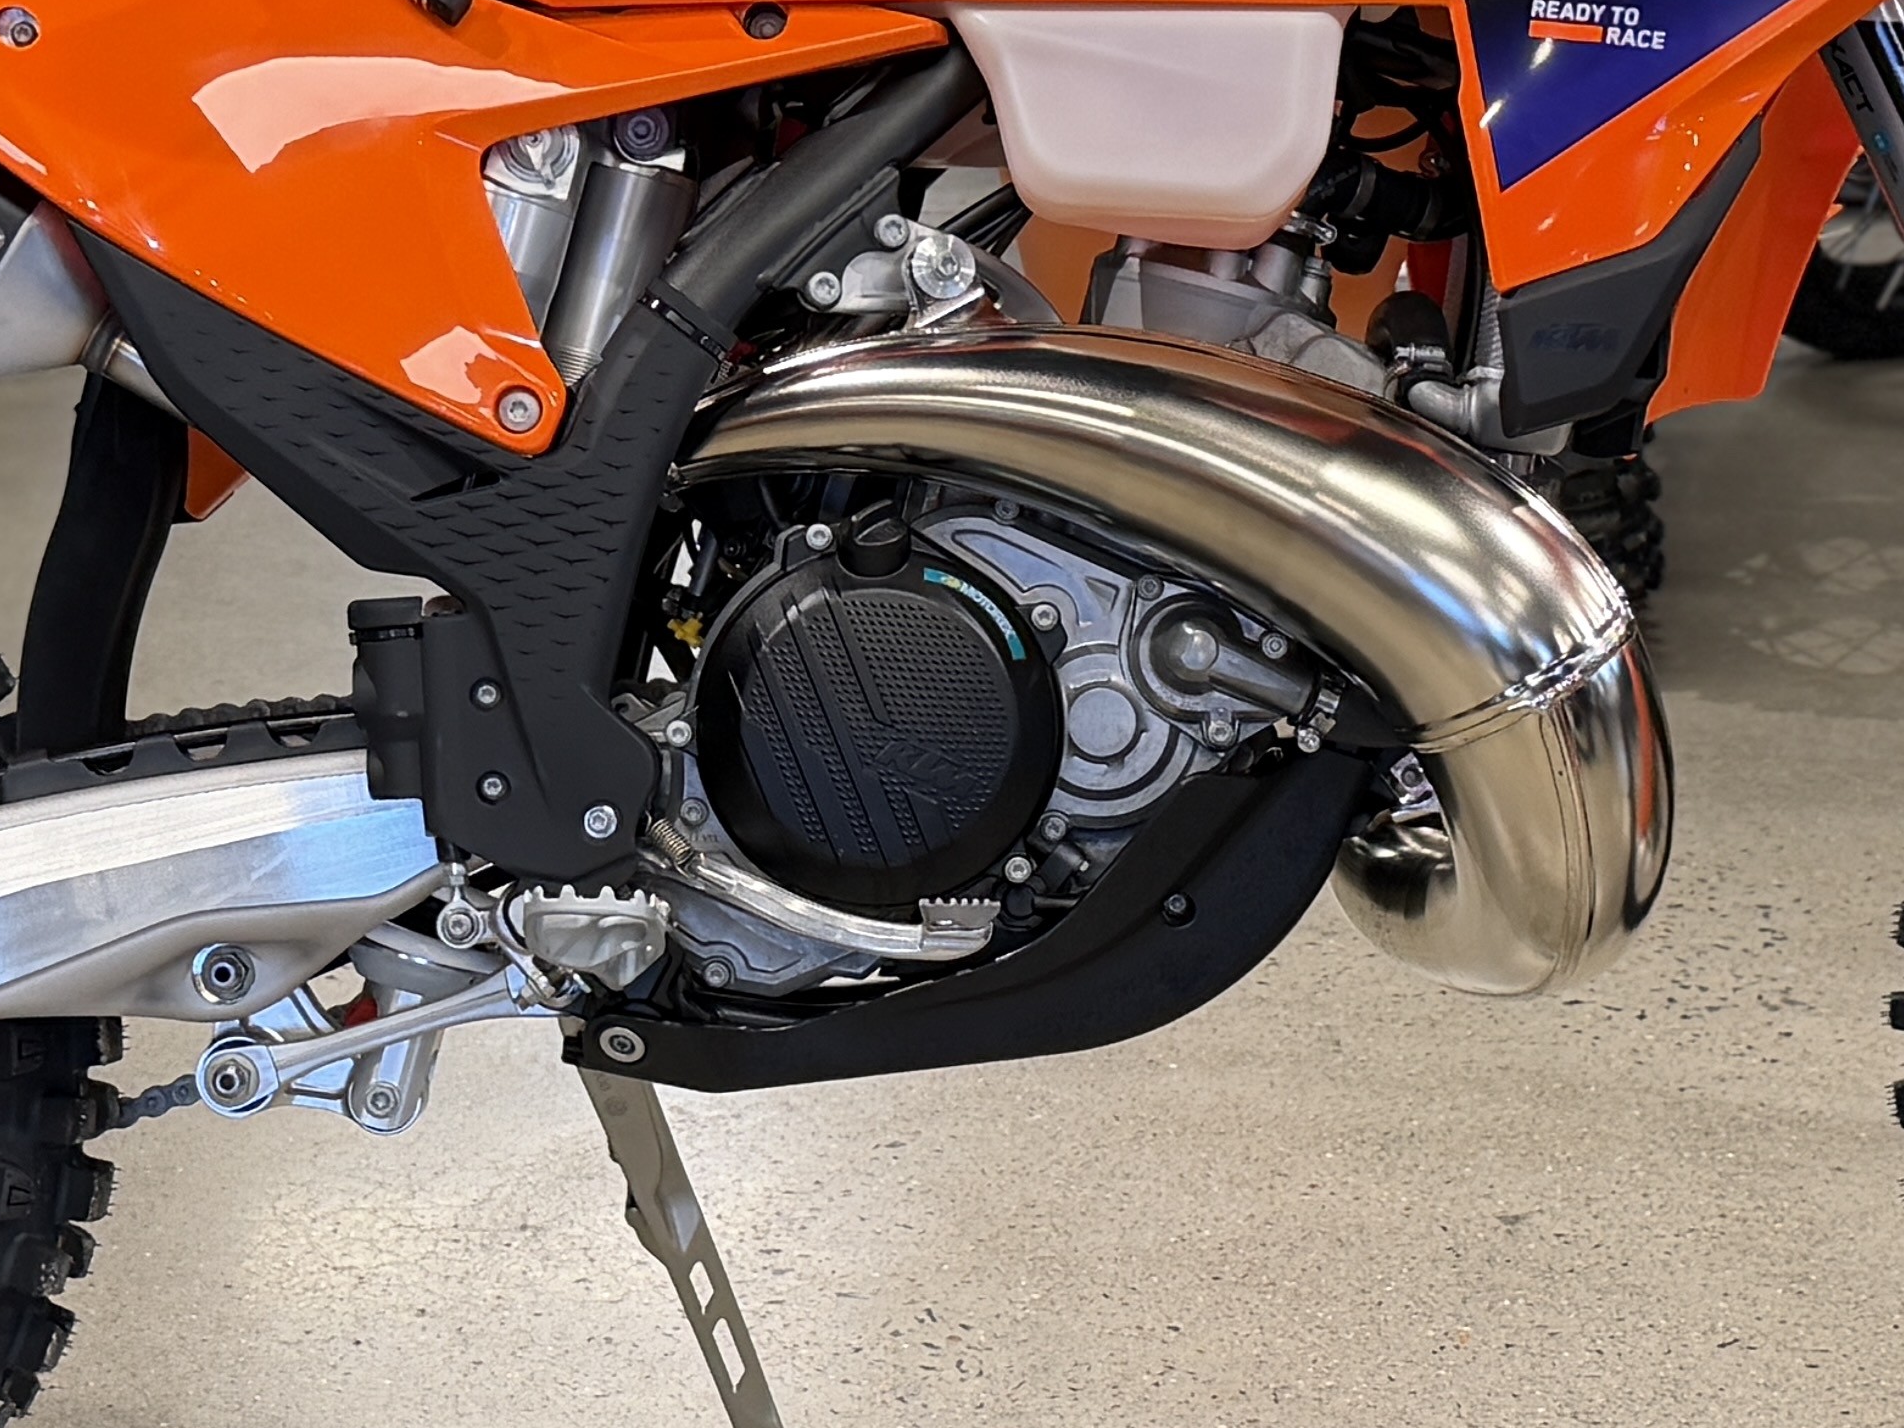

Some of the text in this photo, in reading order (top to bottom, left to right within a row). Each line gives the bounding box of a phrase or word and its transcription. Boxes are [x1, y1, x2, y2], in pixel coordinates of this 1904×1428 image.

[1607, 4, 1640, 26] TO
[1604, 27, 1666, 51] RACE
[1527, 320, 1622, 353] KTM
[874, 739, 982, 798] KTM
